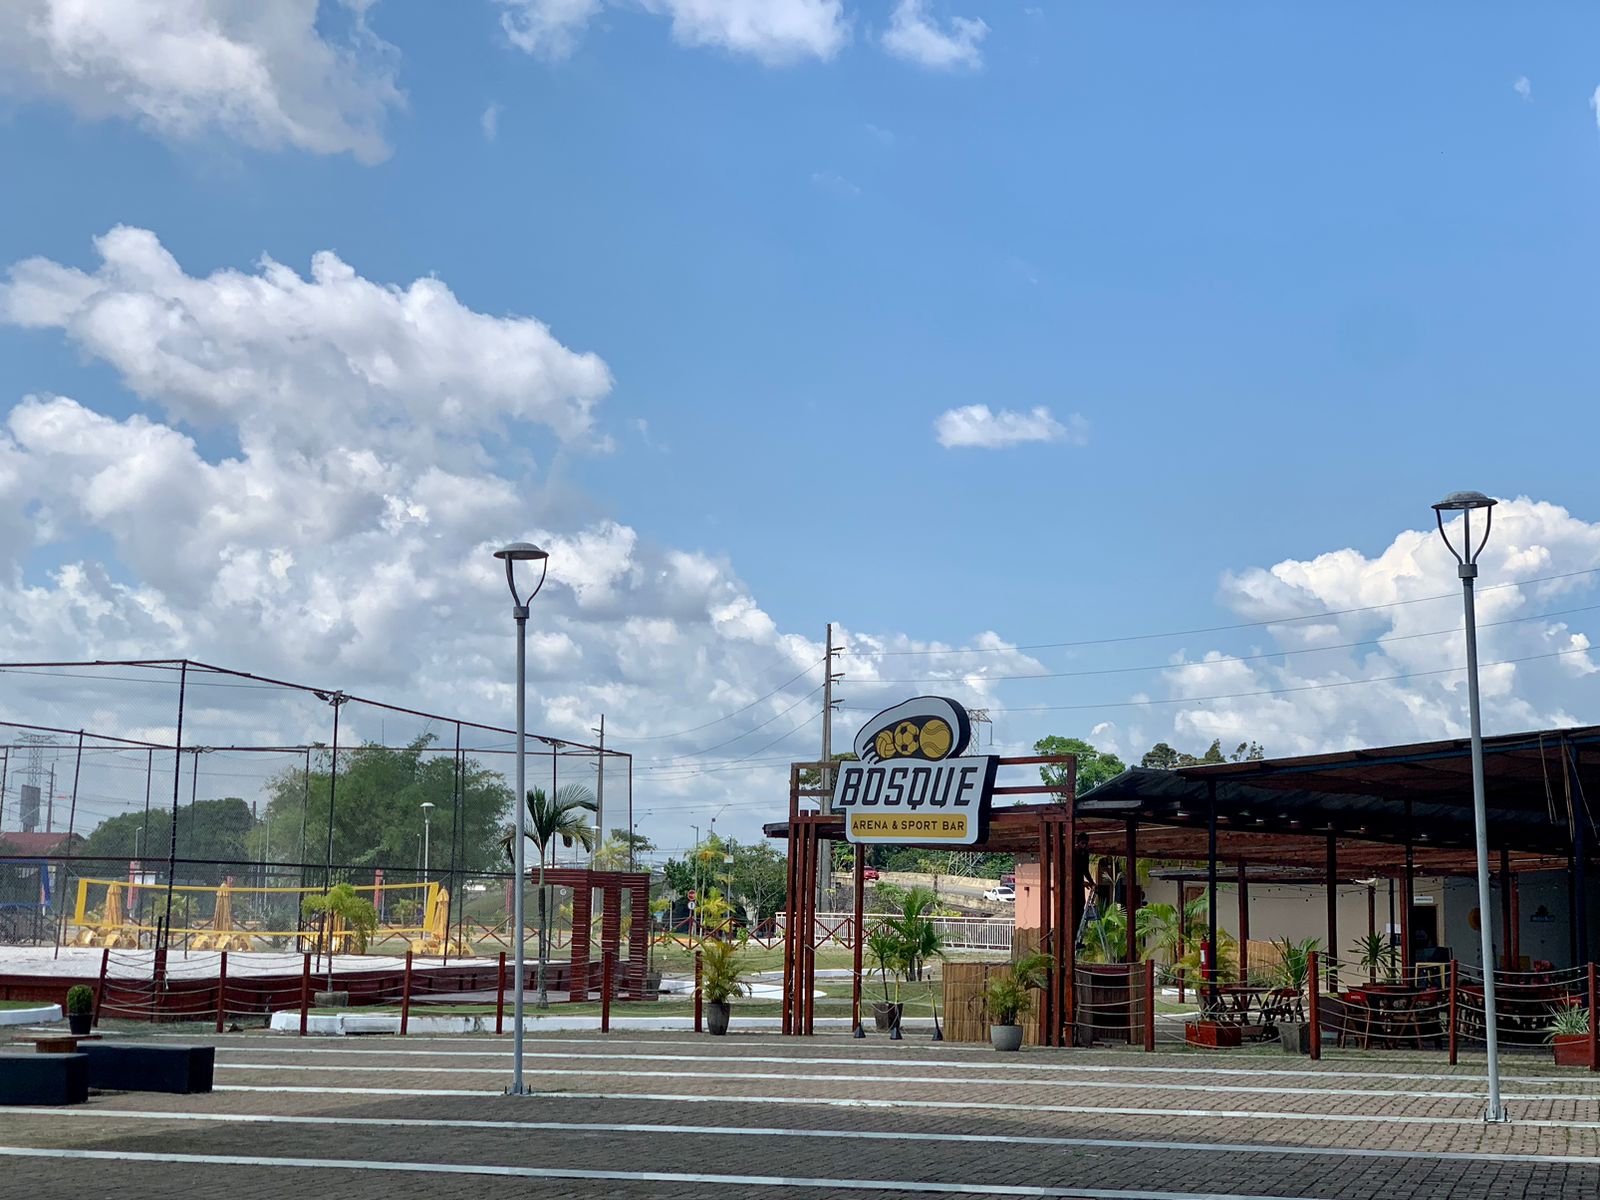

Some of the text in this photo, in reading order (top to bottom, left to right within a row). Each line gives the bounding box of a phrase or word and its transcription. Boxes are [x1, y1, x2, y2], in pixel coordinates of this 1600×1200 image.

[839, 767, 978, 810] BOSQUE
[852, 820, 965, 831] ARENA & SPORT BAR
